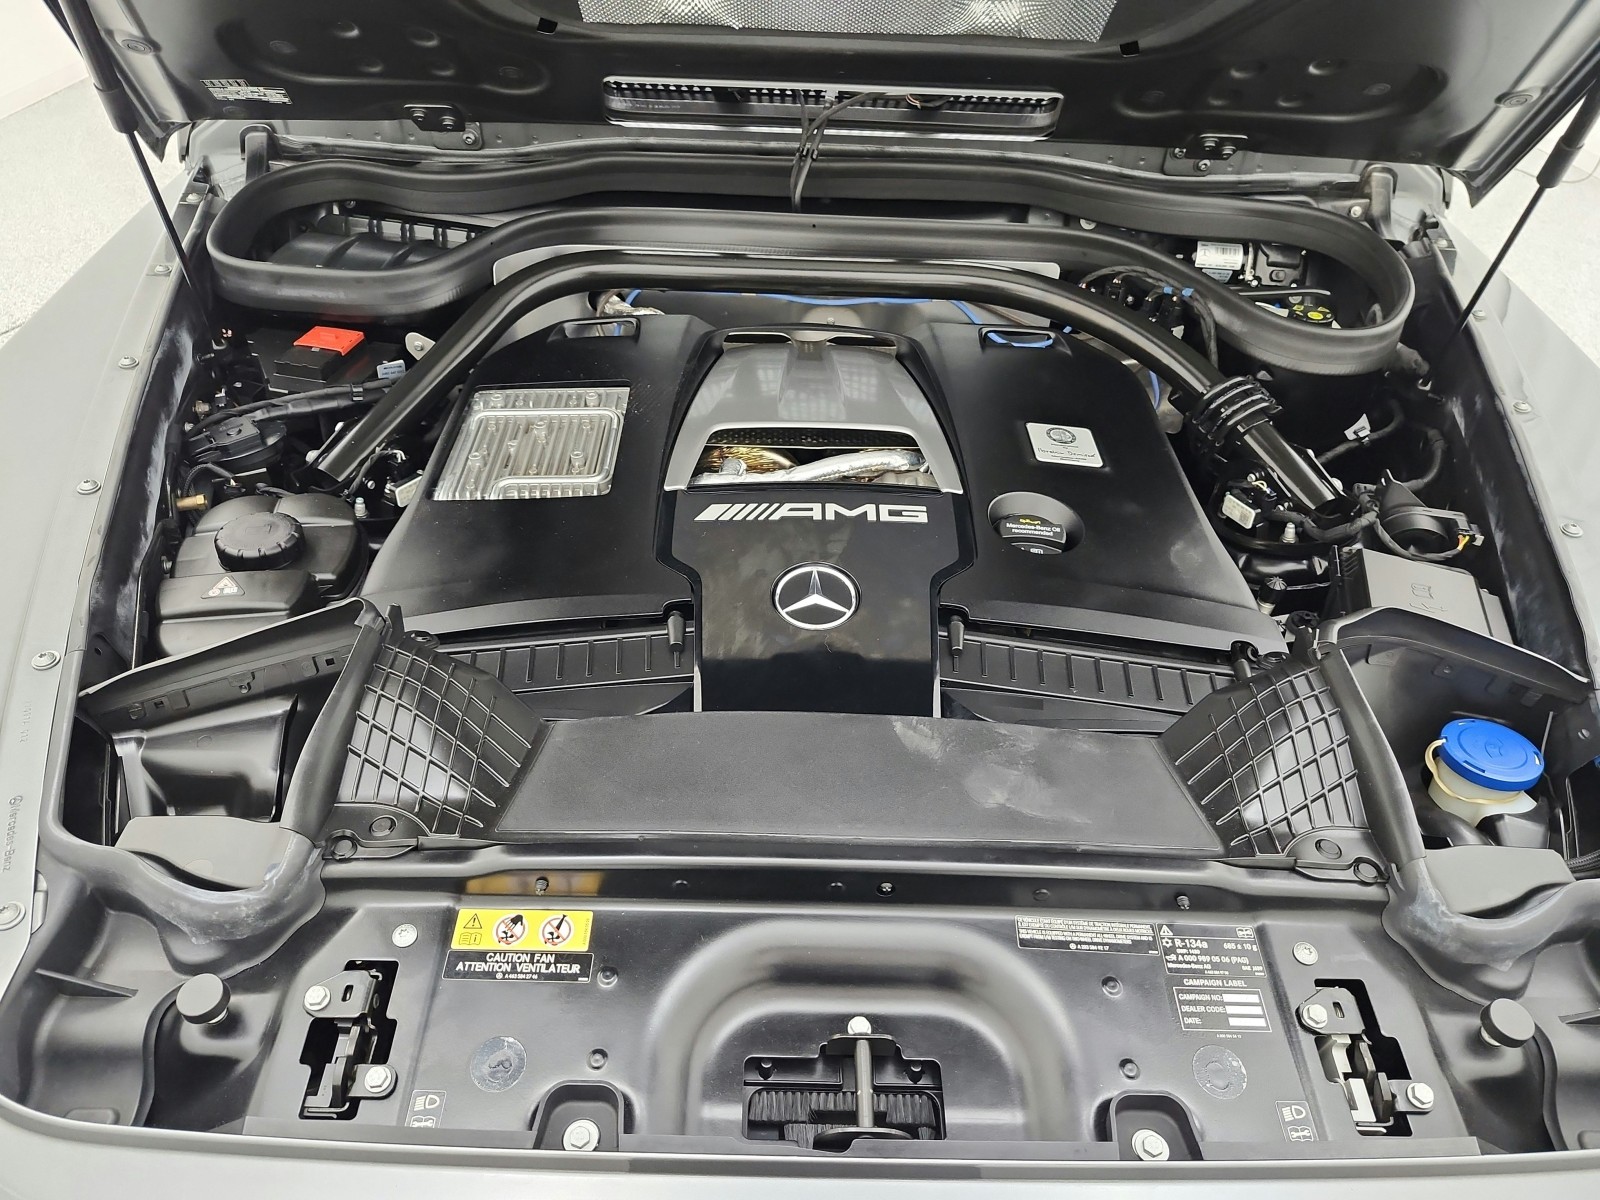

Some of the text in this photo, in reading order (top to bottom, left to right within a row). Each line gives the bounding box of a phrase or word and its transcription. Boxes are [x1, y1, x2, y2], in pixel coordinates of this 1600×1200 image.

[1006, 522, 1052, 531] Mercedes-Benz
[1012, 528, 1053, 536] recommended
[1174, 939, 1208, 949] R-134a
[486, 952, 555, 963] CAUTION FAN
[1230, 957, 1249, 965] (PAG)
[455, 961, 581, 974] ATTENTION VENTILATEUR
[1178, 993, 1211, 1001] CAMPAIGN
